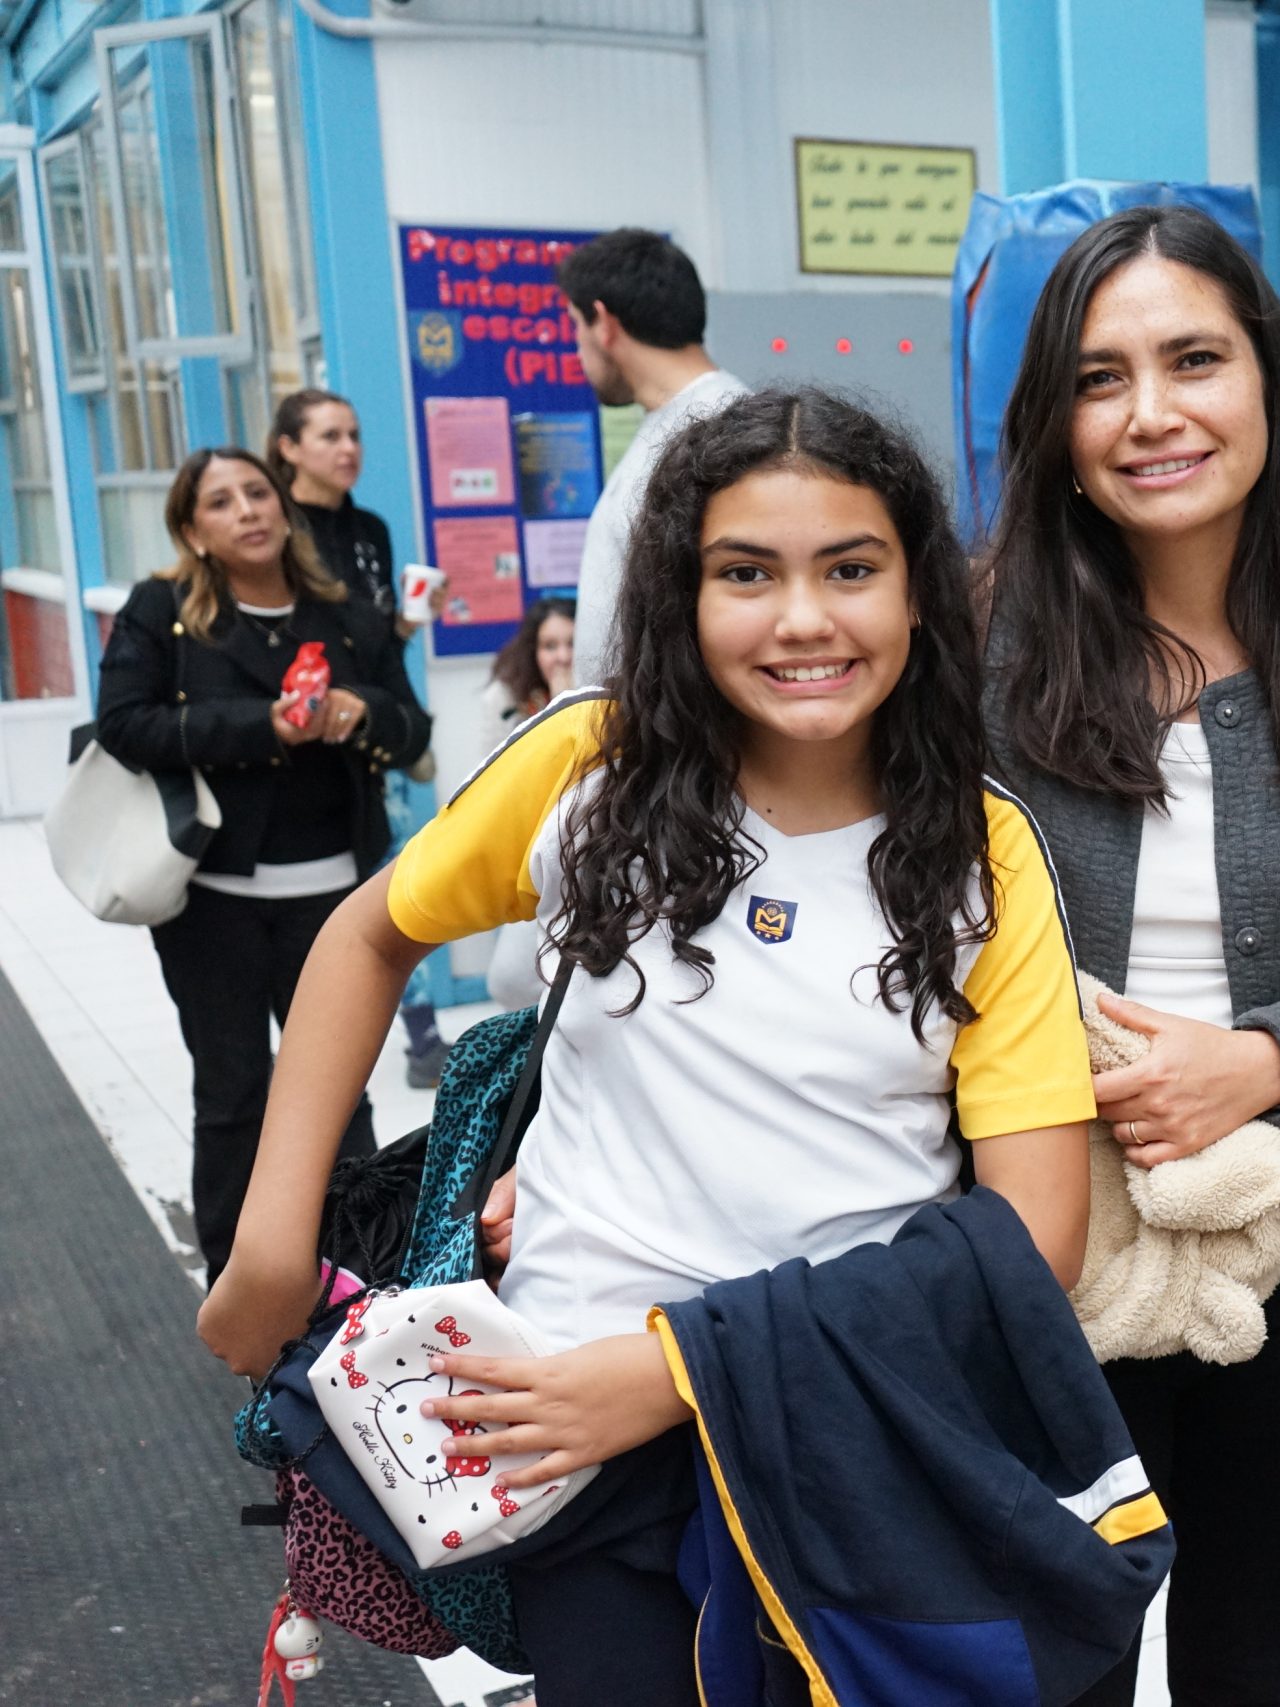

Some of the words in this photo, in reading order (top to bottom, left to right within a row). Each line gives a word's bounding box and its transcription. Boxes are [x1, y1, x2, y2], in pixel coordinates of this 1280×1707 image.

[408, 230, 576, 271] Program
[463, 314, 579, 345] escol
[352, 1421, 380, 1455] Hello
[374, 1455, 397, 1489] Kitty
